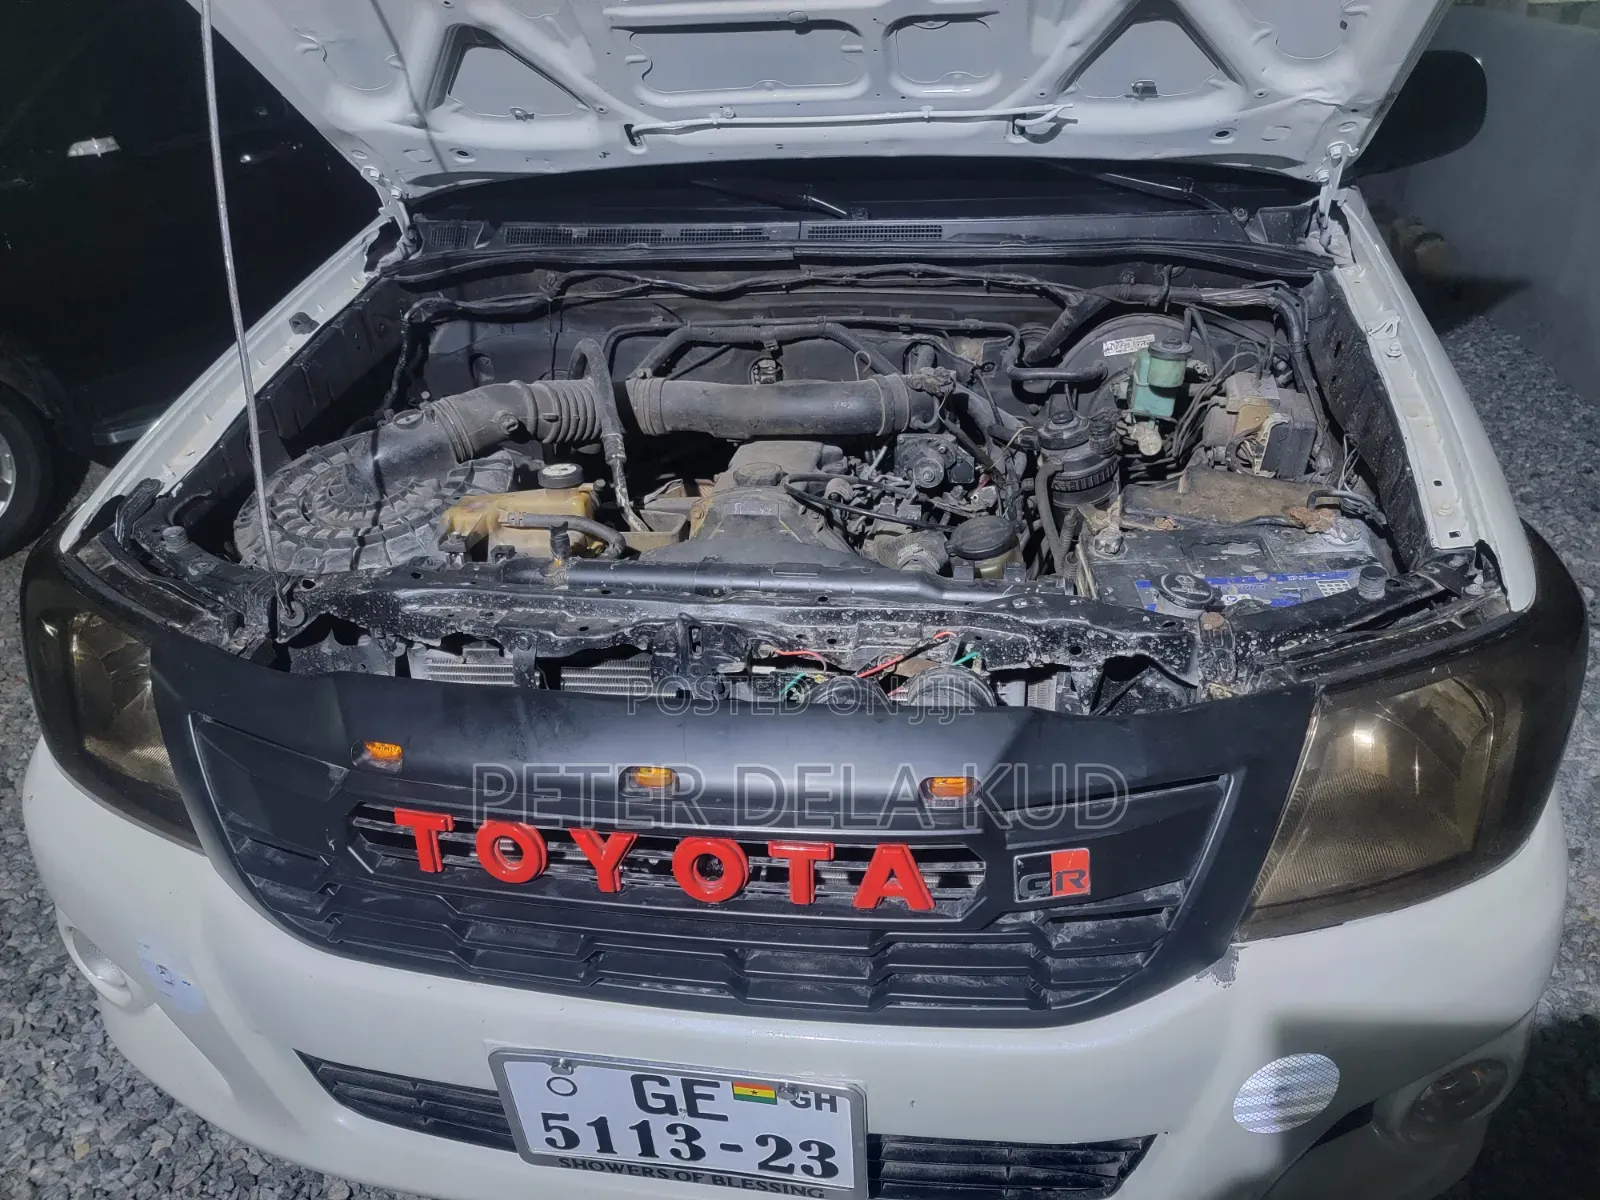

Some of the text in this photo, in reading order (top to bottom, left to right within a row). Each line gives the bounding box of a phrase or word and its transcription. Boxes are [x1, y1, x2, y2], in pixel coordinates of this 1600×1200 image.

[394, 807, 935, 911] TOYOTA
[1019, 869, 1087, 898] GR
[630, 1073, 838, 1122] GE GH
[541, 1112, 839, 1179] 5113-23
[559, 1157, 825, 1199] SHOWERS OF BLESSING
